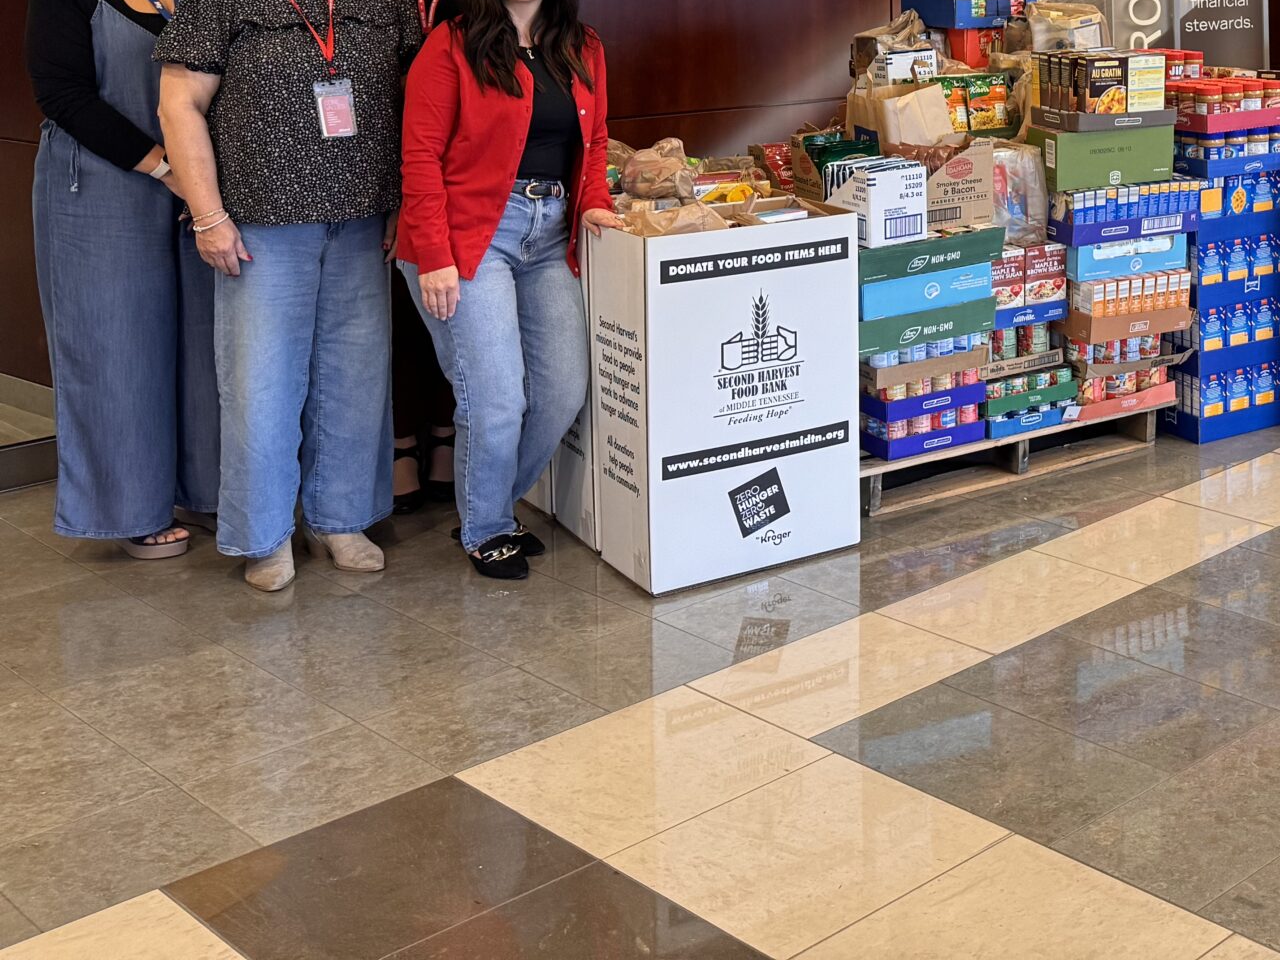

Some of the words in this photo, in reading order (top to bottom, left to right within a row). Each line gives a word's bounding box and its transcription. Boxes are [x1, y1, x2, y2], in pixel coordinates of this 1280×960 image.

[1185, 17, 1253, 33] stewards.
[1100, 68, 1122, 78] GRATIN
[936, 180, 960, 189] Smokey
[961, 177, 983, 185] Cheese
[951, 185, 976, 194] Bacon
[957, 194, 987, 202] POTATOES
[669, 261, 714, 277] DONATE
[717, 256, 749, 269] YOUR
[751, 252, 782, 266] FOOD
[785, 248, 815, 261] ITEMS
[818, 243, 842, 257] HERE
[931, 251, 961, 264] NON-GMO
[1034, 261, 1053, 269] MAPLE
[1026, 267, 1048, 275] BROWN
[599, 315, 615, 332] Second
[923, 321, 954, 335] NON-GMO
[602, 348, 613, 365] food
[619, 361, 635, 376] people
[624, 347, 642, 361] provide
[717, 372, 755, 390] SECOND
[758, 364, 801, 383] HARVEST
[731, 385, 758, 400] FOOD
[761, 379, 788, 394] BANK
[727, 400, 757, 412] MIDDLE
[760, 391, 799, 406] TENNESSEE
[728, 413, 763, 425] Feeding
[614, 437, 634, 459] donations
[667, 428, 845, 473] www.secondharvestmidtn.org
[609, 450, 619, 469] help
[619, 461, 634, 476] people
[734, 485, 760, 504] ZERO
[737, 484, 779, 512] HUNGER
[740, 502, 765, 520] ZERO
[743, 505, 776, 528] WASTE
[760, 529, 792, 546] Kroger
